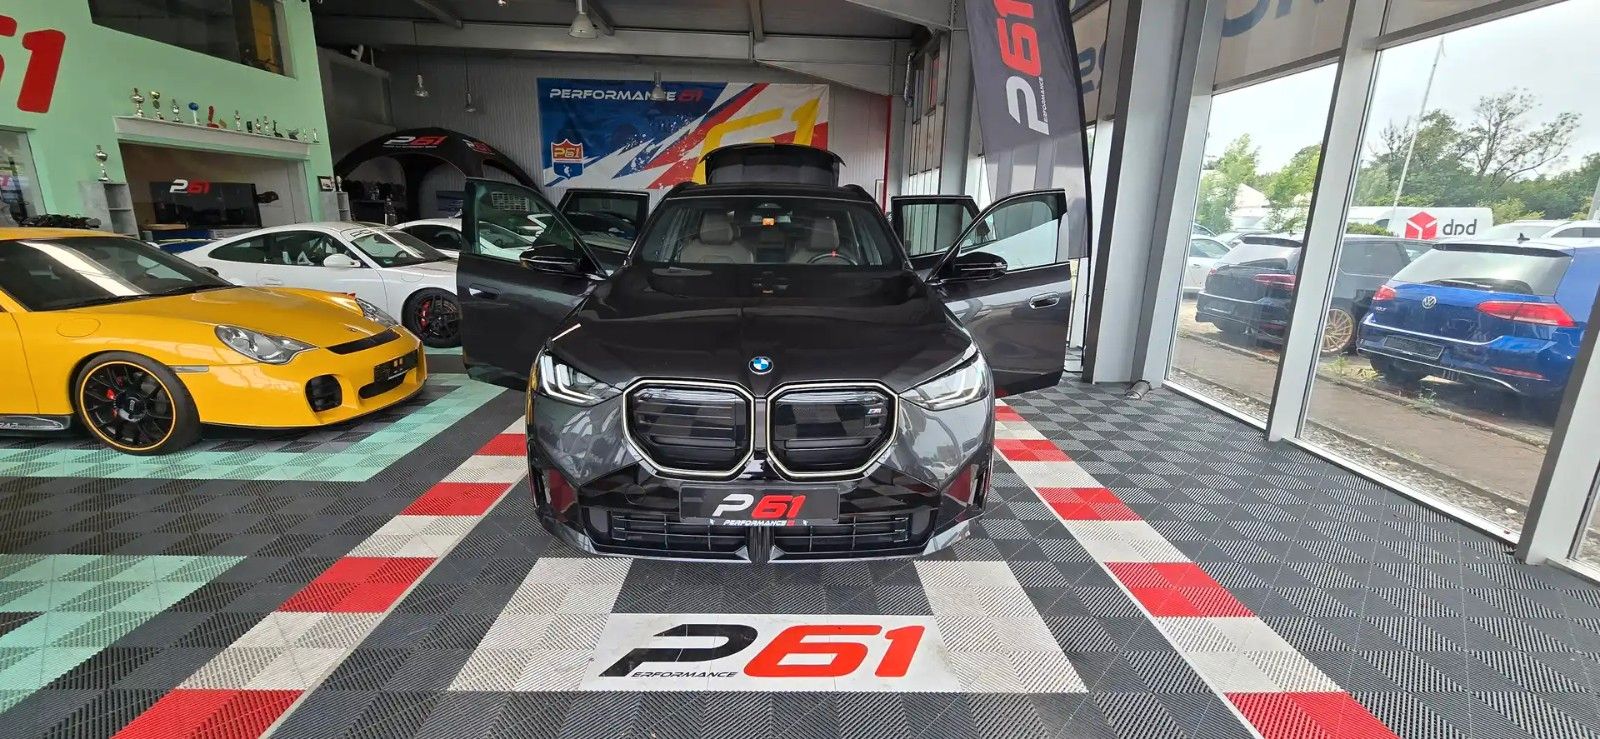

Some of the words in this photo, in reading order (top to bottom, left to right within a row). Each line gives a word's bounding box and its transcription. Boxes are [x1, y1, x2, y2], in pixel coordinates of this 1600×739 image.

[0, 14, 66, 114] 1
[549, 88, 677, 102] PERFORMANE
[553, 147, 581, 158] P61
[1442, 218, 1478, 236] dpd
[711, 493, 807, 519] P61
[598, 623, 926, 678] P61
